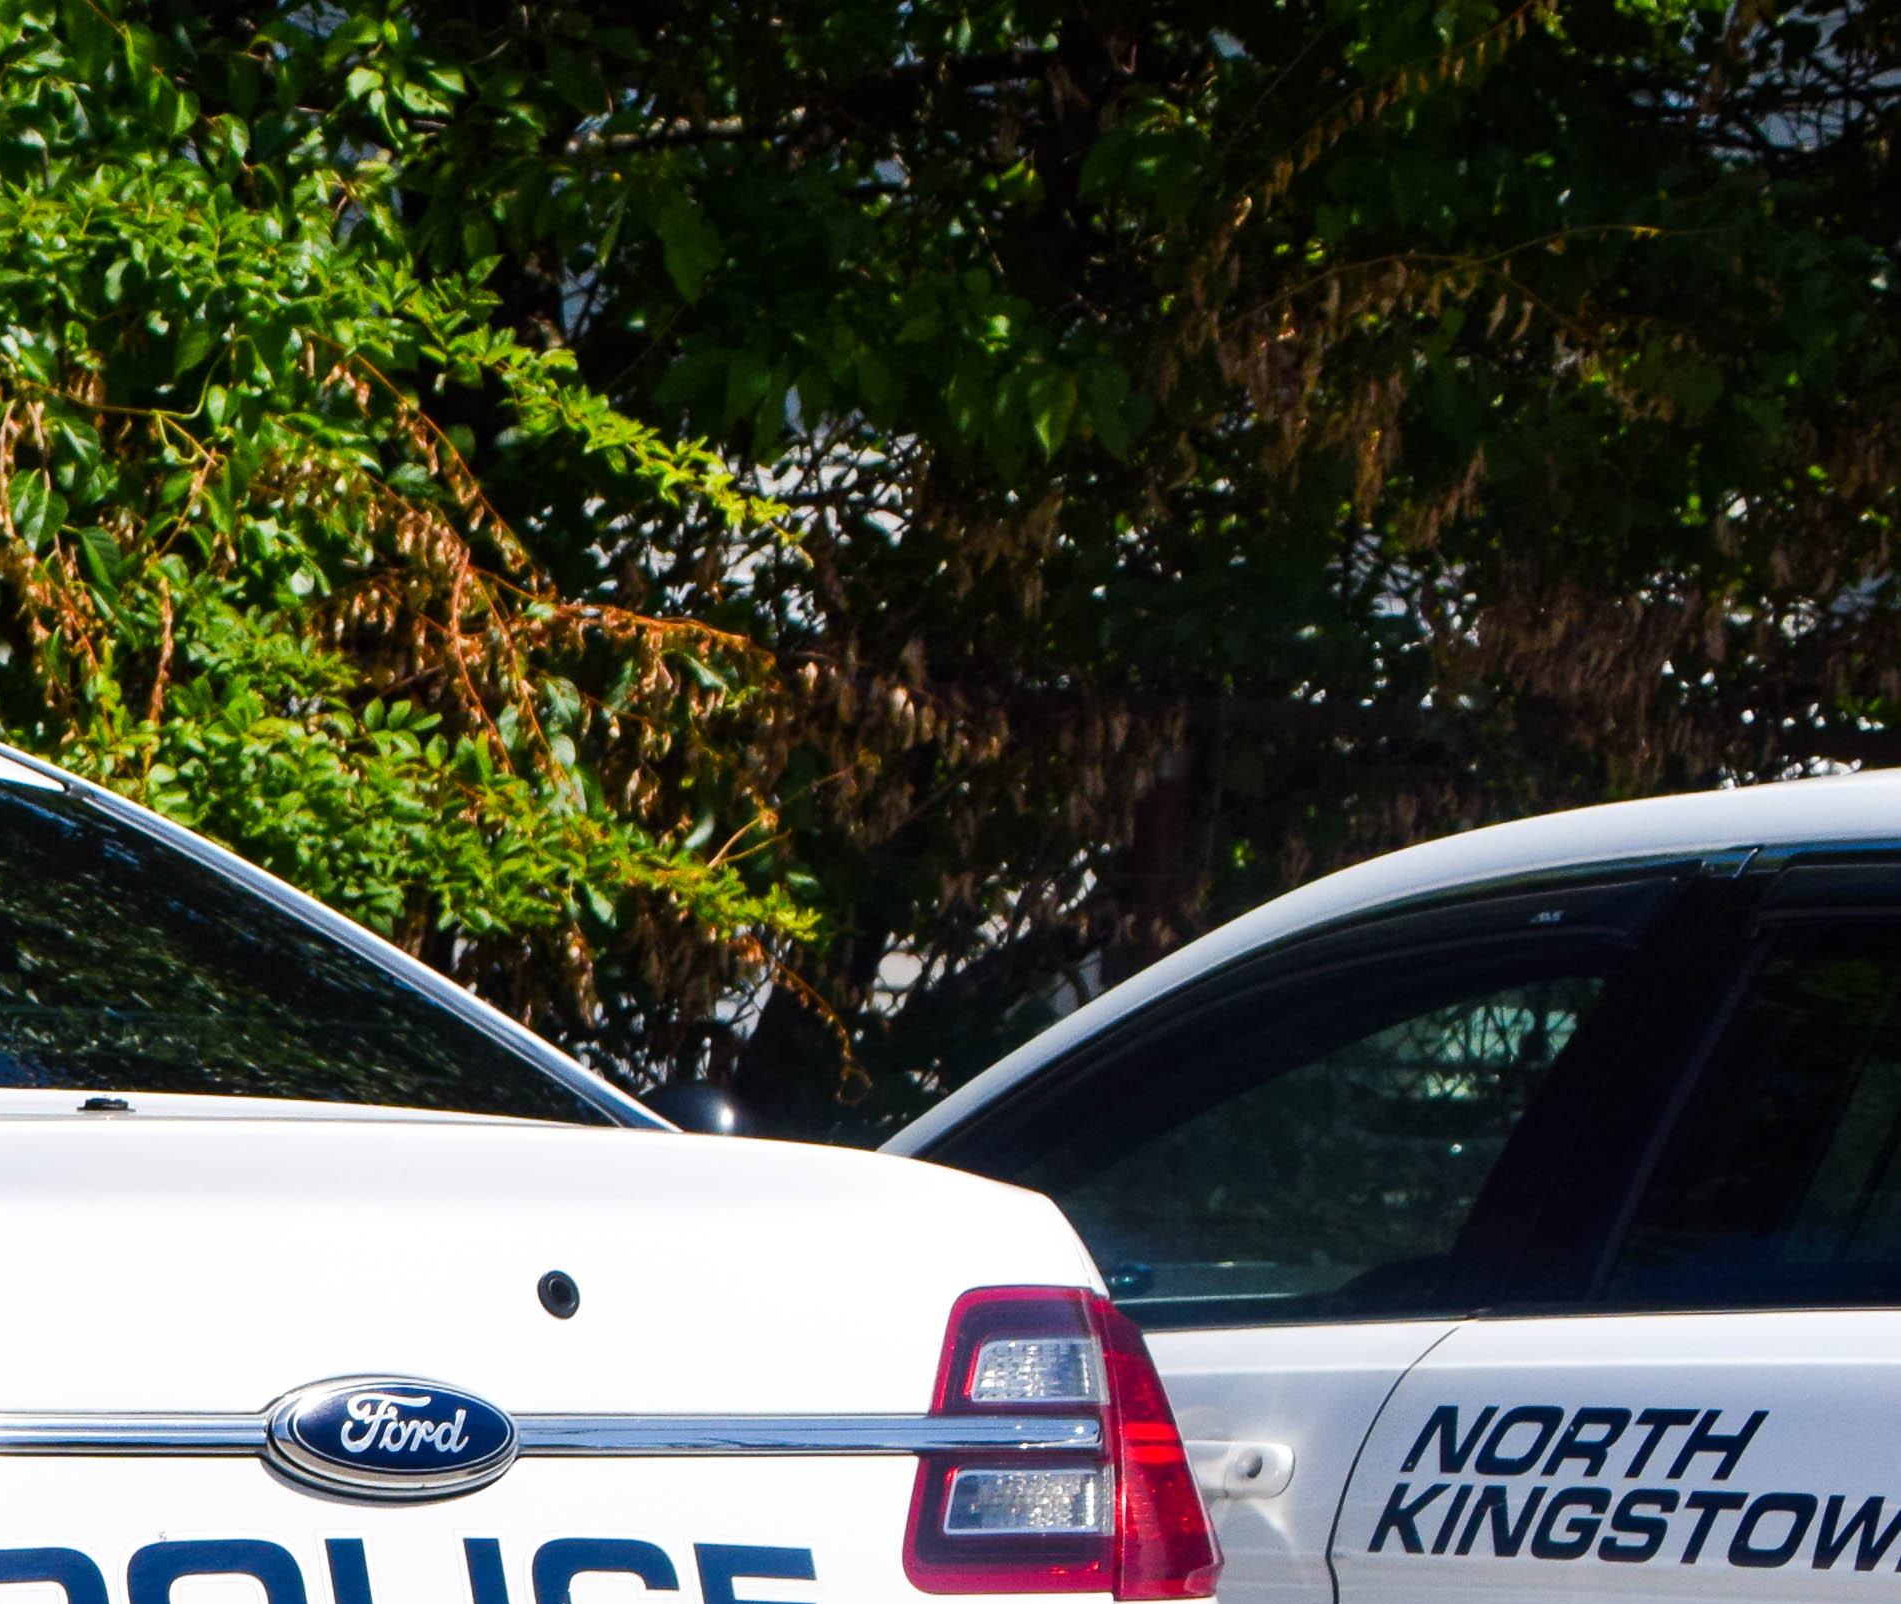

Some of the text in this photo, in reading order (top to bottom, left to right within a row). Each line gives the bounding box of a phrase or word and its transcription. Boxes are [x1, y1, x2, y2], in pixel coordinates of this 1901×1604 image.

[341, 1392, 470, 1453] Ford
[1400, 1405, 1770, 1480] NORTH
[1367, 1483, 1901, 1573] KINGSTOW
